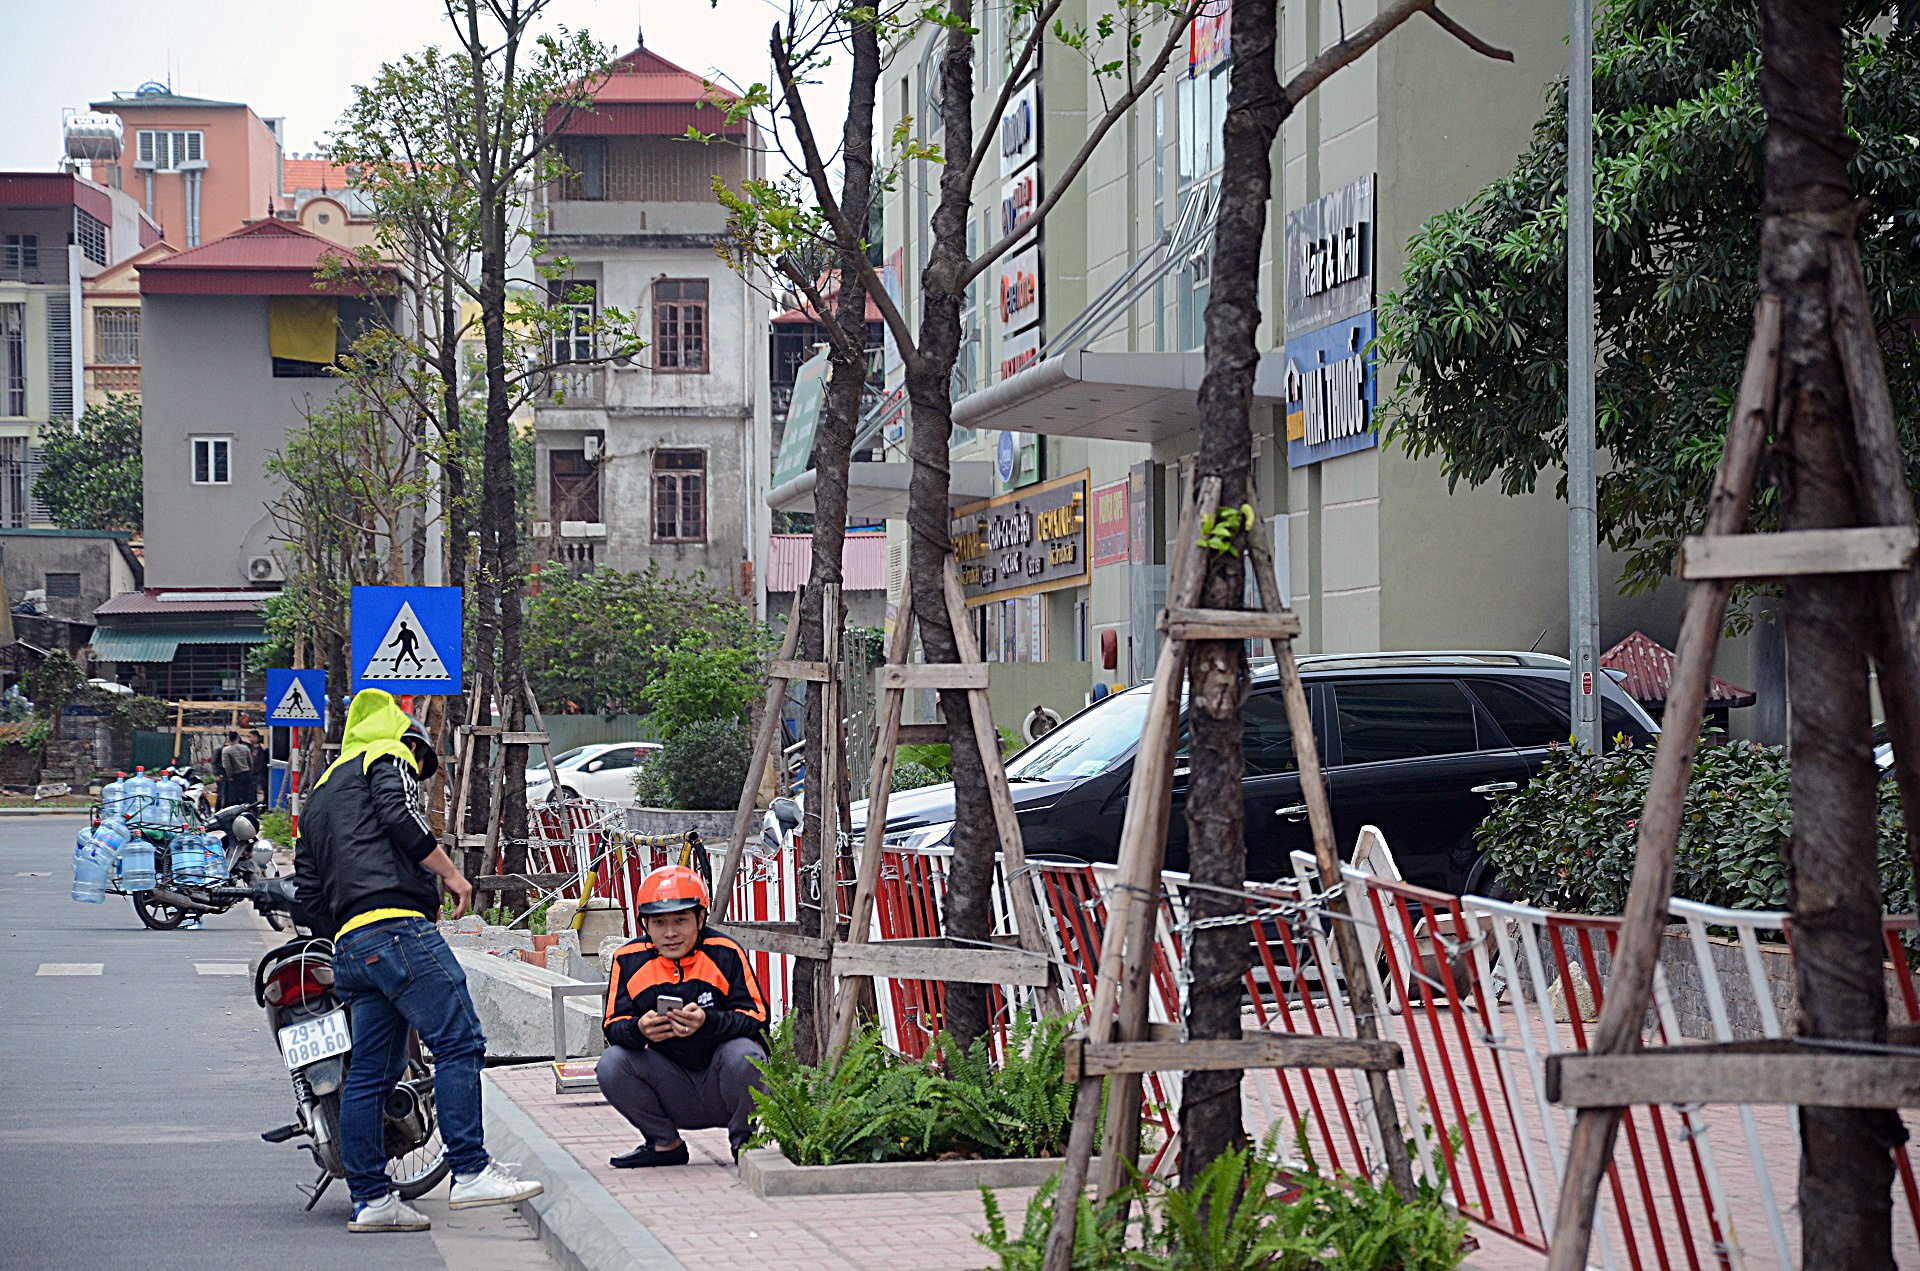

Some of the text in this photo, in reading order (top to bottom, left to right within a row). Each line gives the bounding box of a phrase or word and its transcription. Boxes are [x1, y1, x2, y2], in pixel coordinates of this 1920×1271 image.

[1304, 221, 1359, 297] Hair & Nail
[1302, 327, 1363, 446] NHÀ THUỐC
[287, 1032, 347, 1065] 088.60
[289, 1016, 336, 1046] 29-Y1
